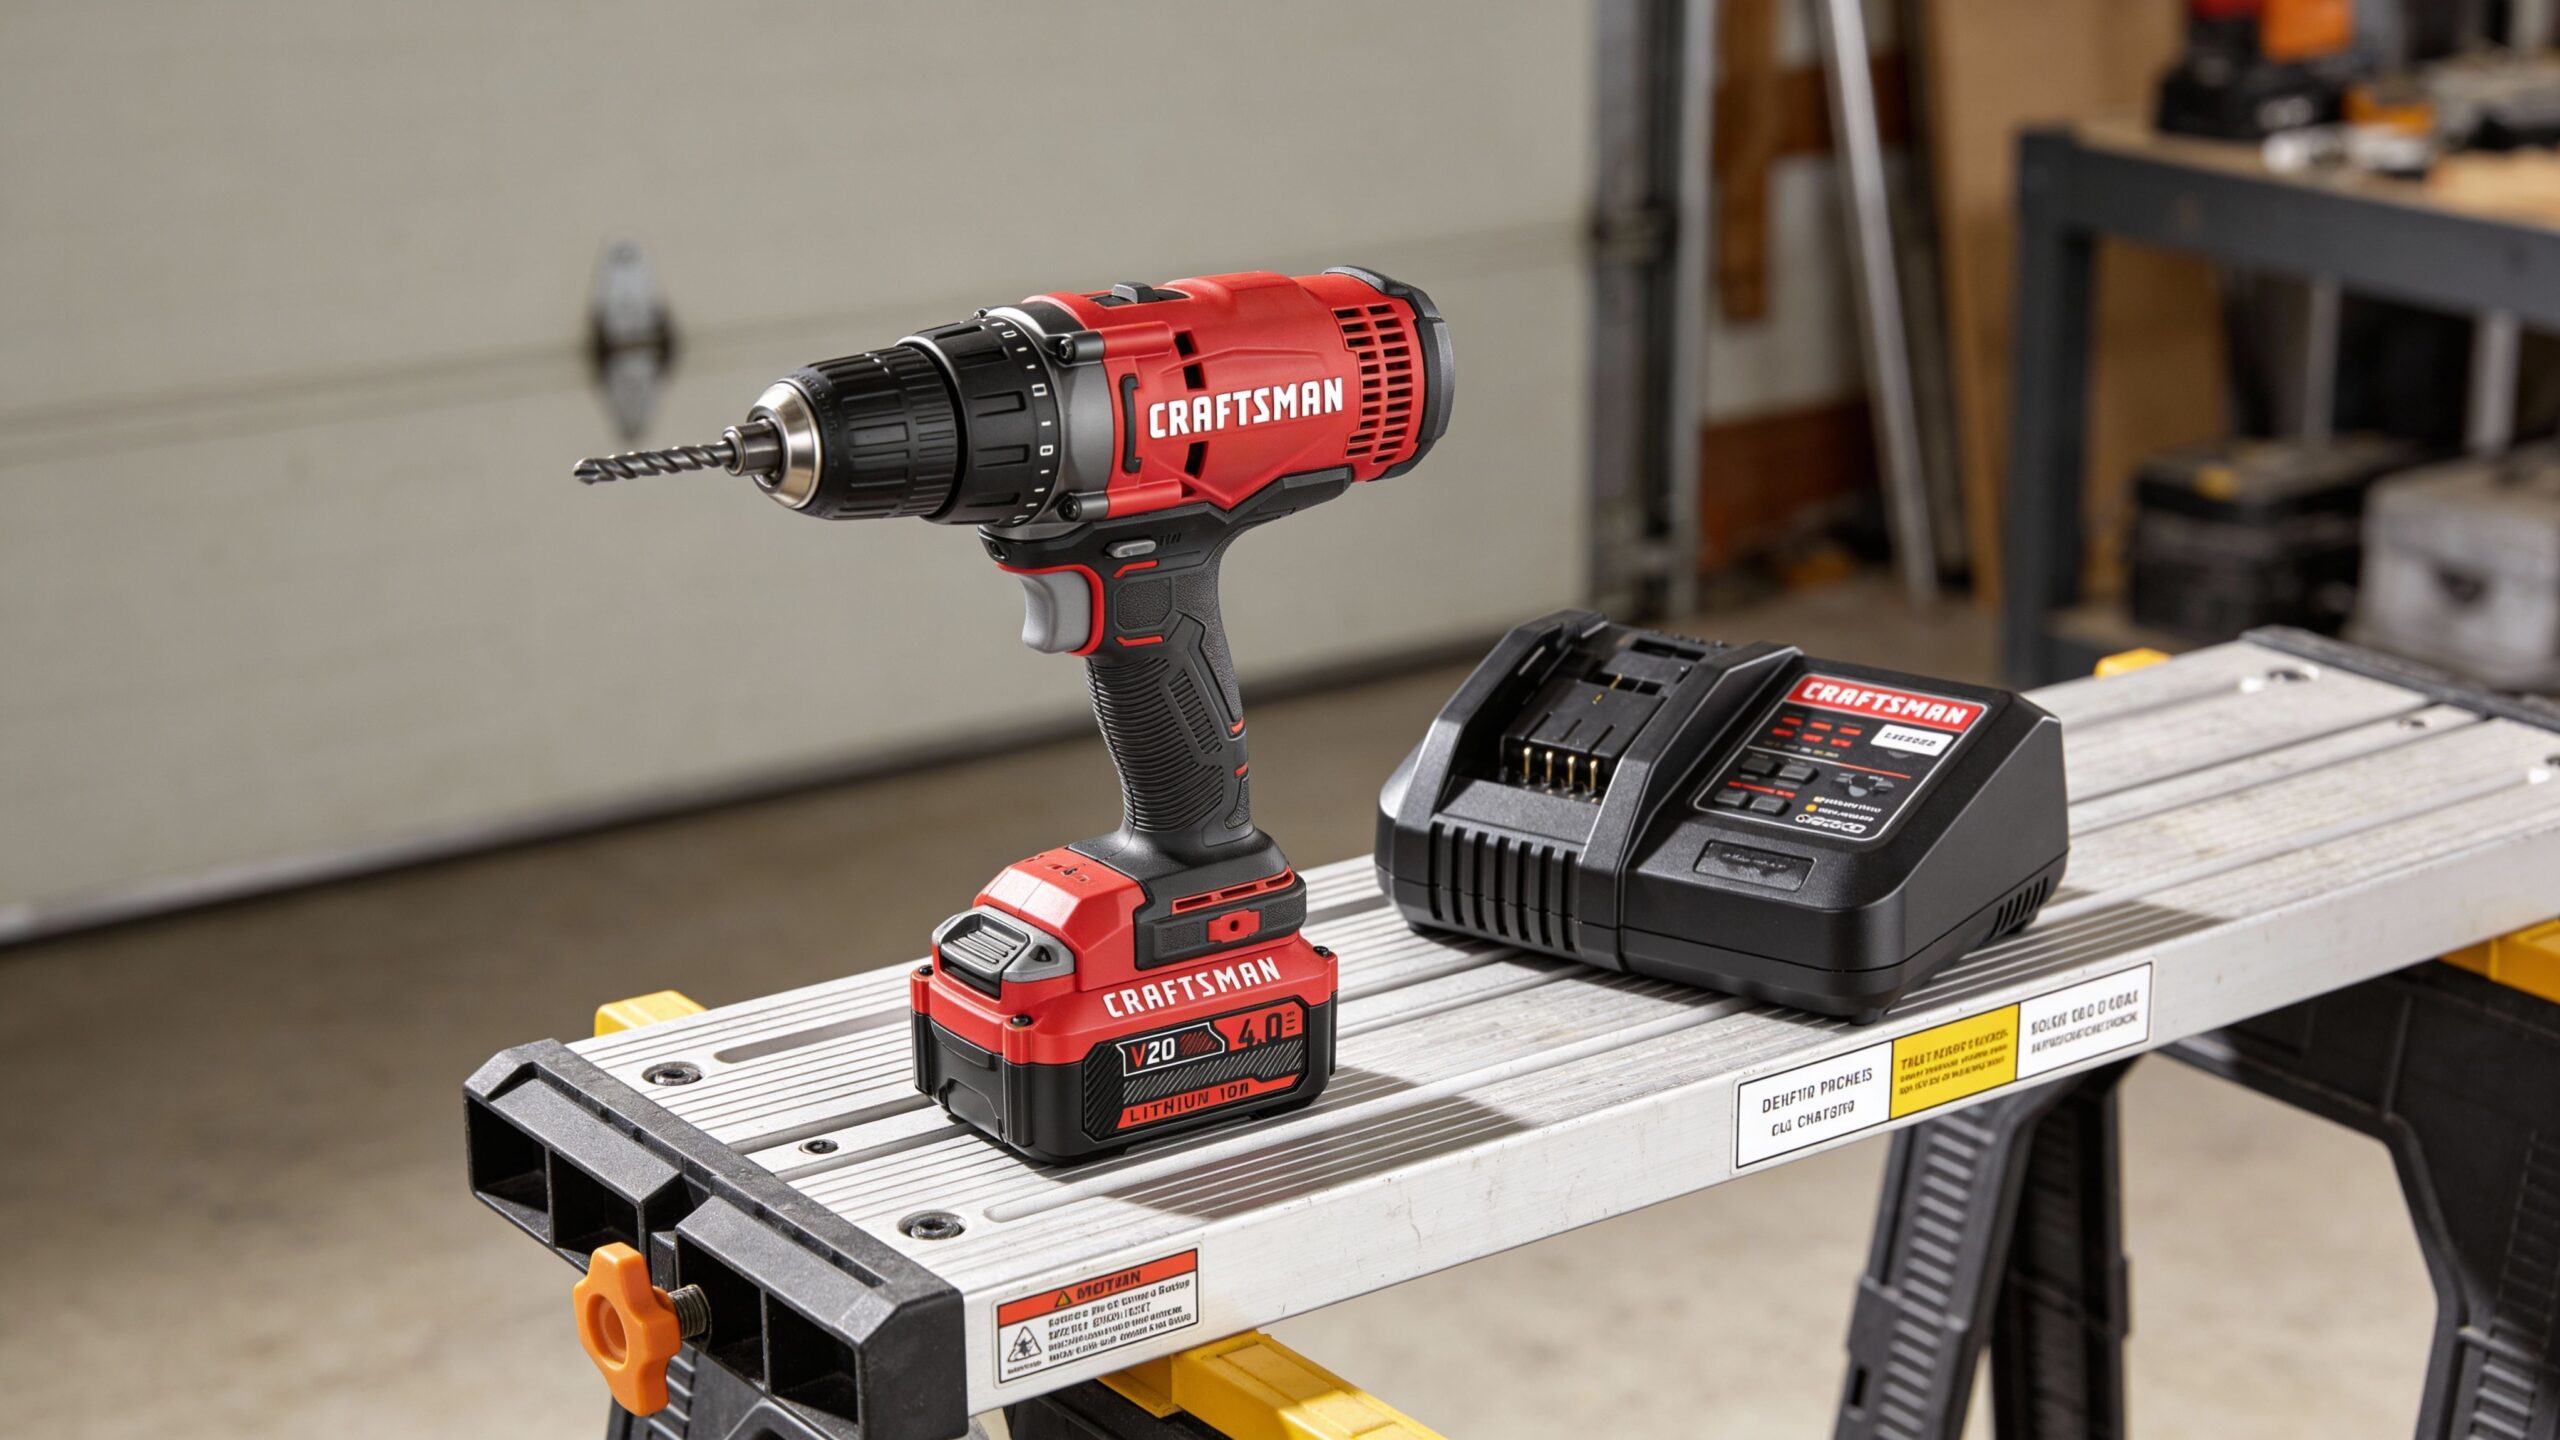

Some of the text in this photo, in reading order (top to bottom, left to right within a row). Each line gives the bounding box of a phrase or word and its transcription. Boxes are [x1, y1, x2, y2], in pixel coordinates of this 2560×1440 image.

[1149, 376, 1344, 439] CRAFTSMAN
[1801, 681, 1969, 725] CRAFTSMAN
[1102, 956, 1282, 1018] CRAFTSMAN
[1237, 1012, 1283, 1048] 4.0
[1130, 1037, 1176, 1068] V20
